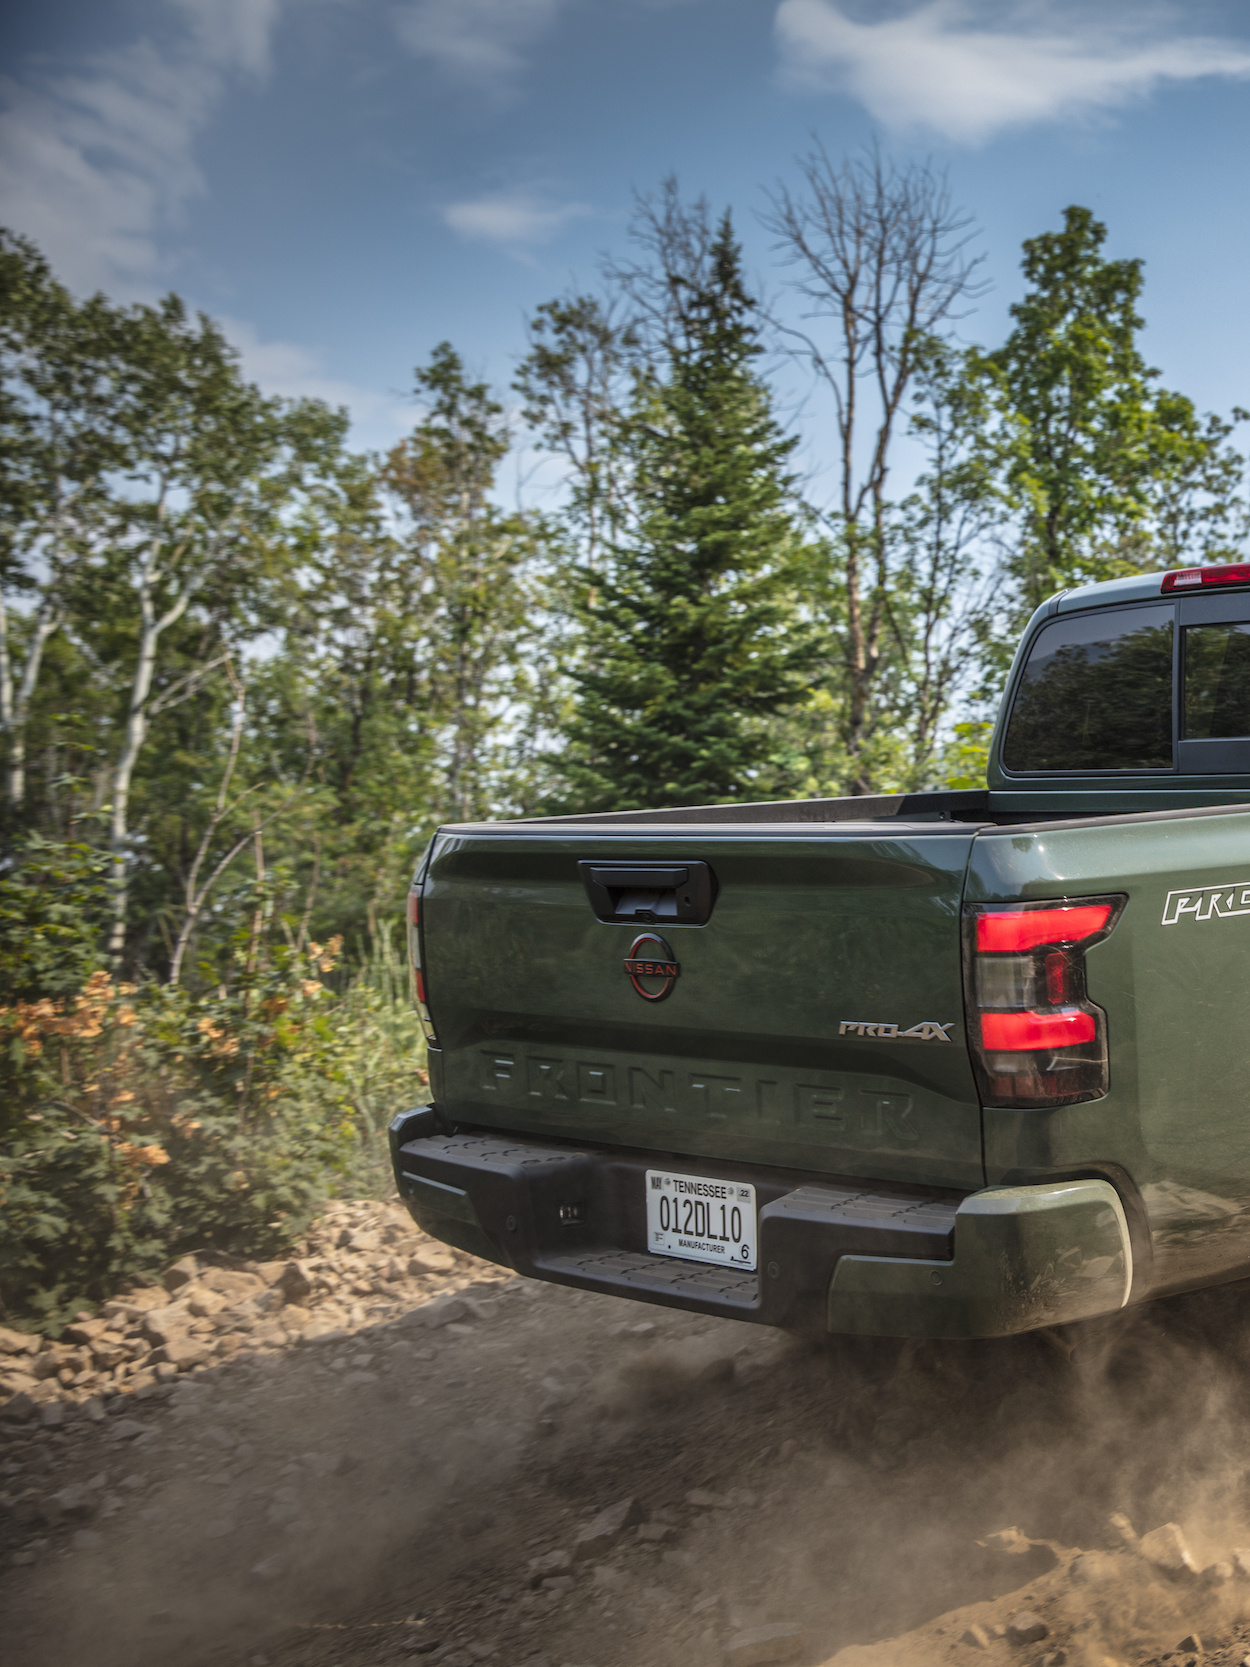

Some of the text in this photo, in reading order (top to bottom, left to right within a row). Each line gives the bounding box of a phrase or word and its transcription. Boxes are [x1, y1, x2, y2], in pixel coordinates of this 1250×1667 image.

[624, 961, 677, 976] NISSAN
[479, 1049, 920, 1140] FRONTIER
[651, 1176, 662, 1190] MAY
[673, 1179, 727, 1200] TENNESSEE
[739, 1189, 749, 1198] 22
[660, 1195, 742, 1243] 012DL10
[678, 1238, 726, 1254] MANUFACTURER
